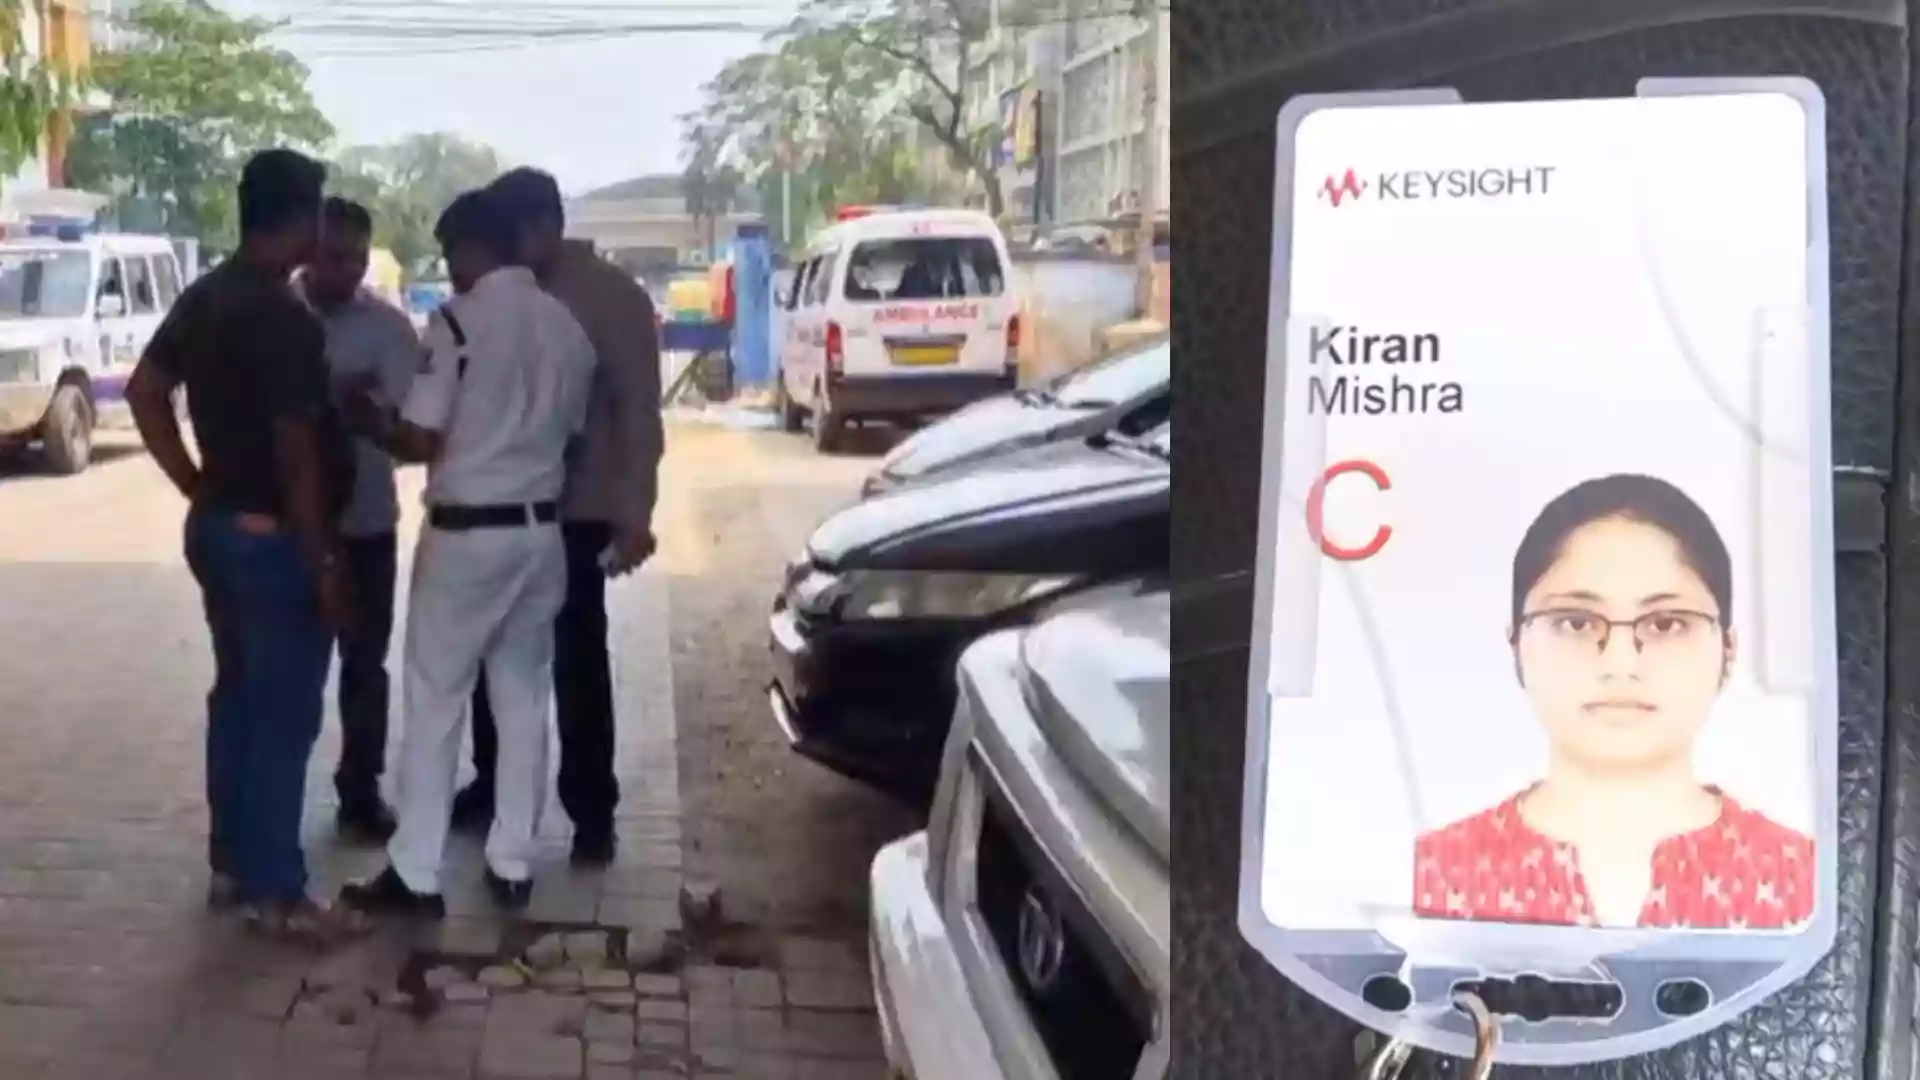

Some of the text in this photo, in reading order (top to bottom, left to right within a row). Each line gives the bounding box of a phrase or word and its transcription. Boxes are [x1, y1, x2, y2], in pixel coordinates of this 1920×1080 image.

[1378, 167, 1555, 199] KEYSIGHT
[1308, 326, 1440, 364] Kiran
[1307, 374, 1463, 415] Mishra
[1305, 459, 1392, 561] C
